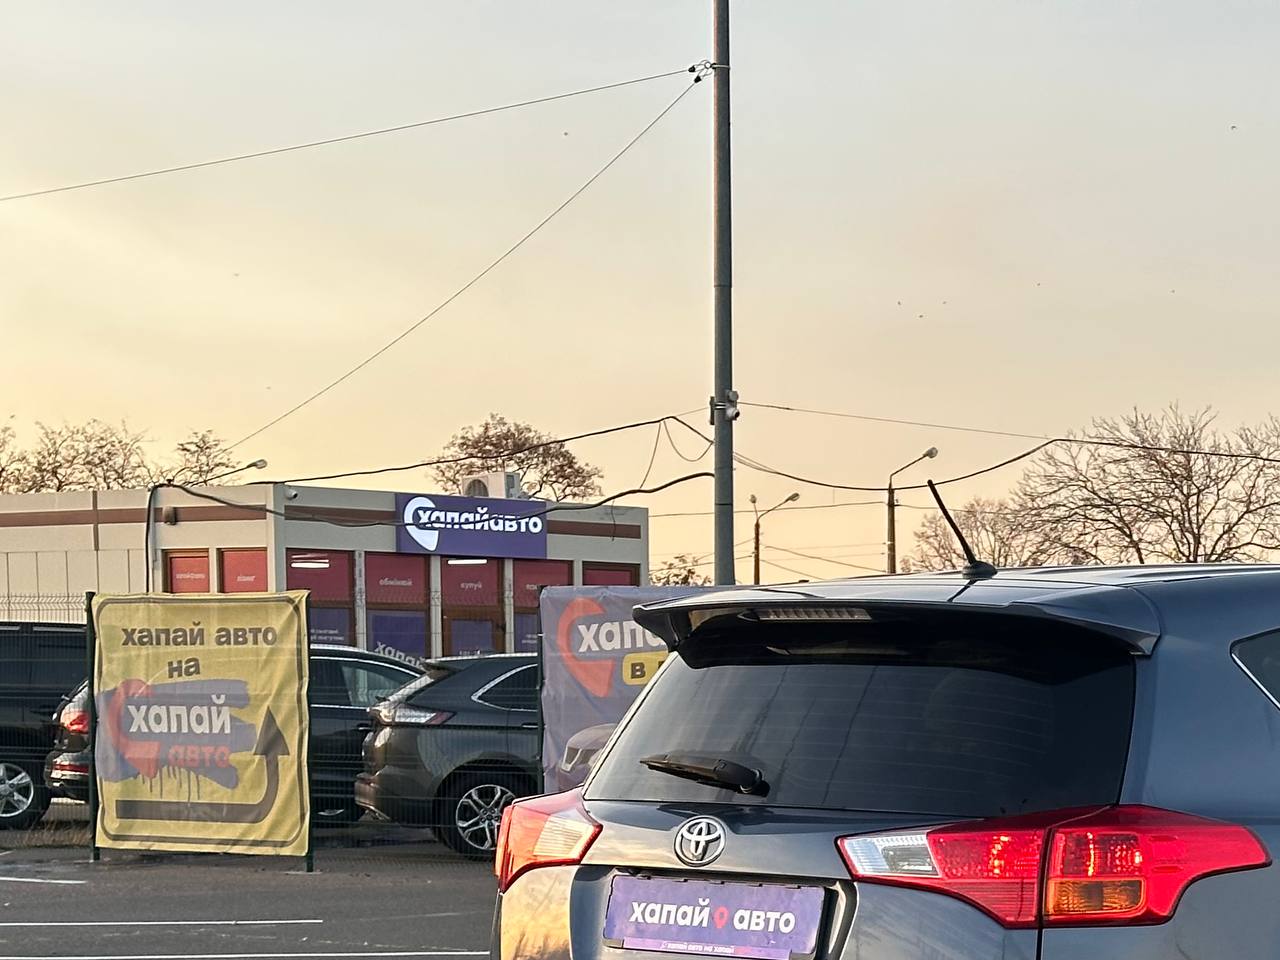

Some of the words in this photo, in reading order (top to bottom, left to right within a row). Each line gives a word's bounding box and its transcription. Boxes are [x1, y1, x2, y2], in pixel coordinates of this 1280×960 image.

[122, 621, 205, 646] хапай
[215, 626, 278, 646] авто
[167, 657, 200, 679] на
[127, 694, 231, 734] хапай
[168, 745, 230, 768] авто
[629, 898, 710, 928] хапай
[733, 909, 796, 934] авто
